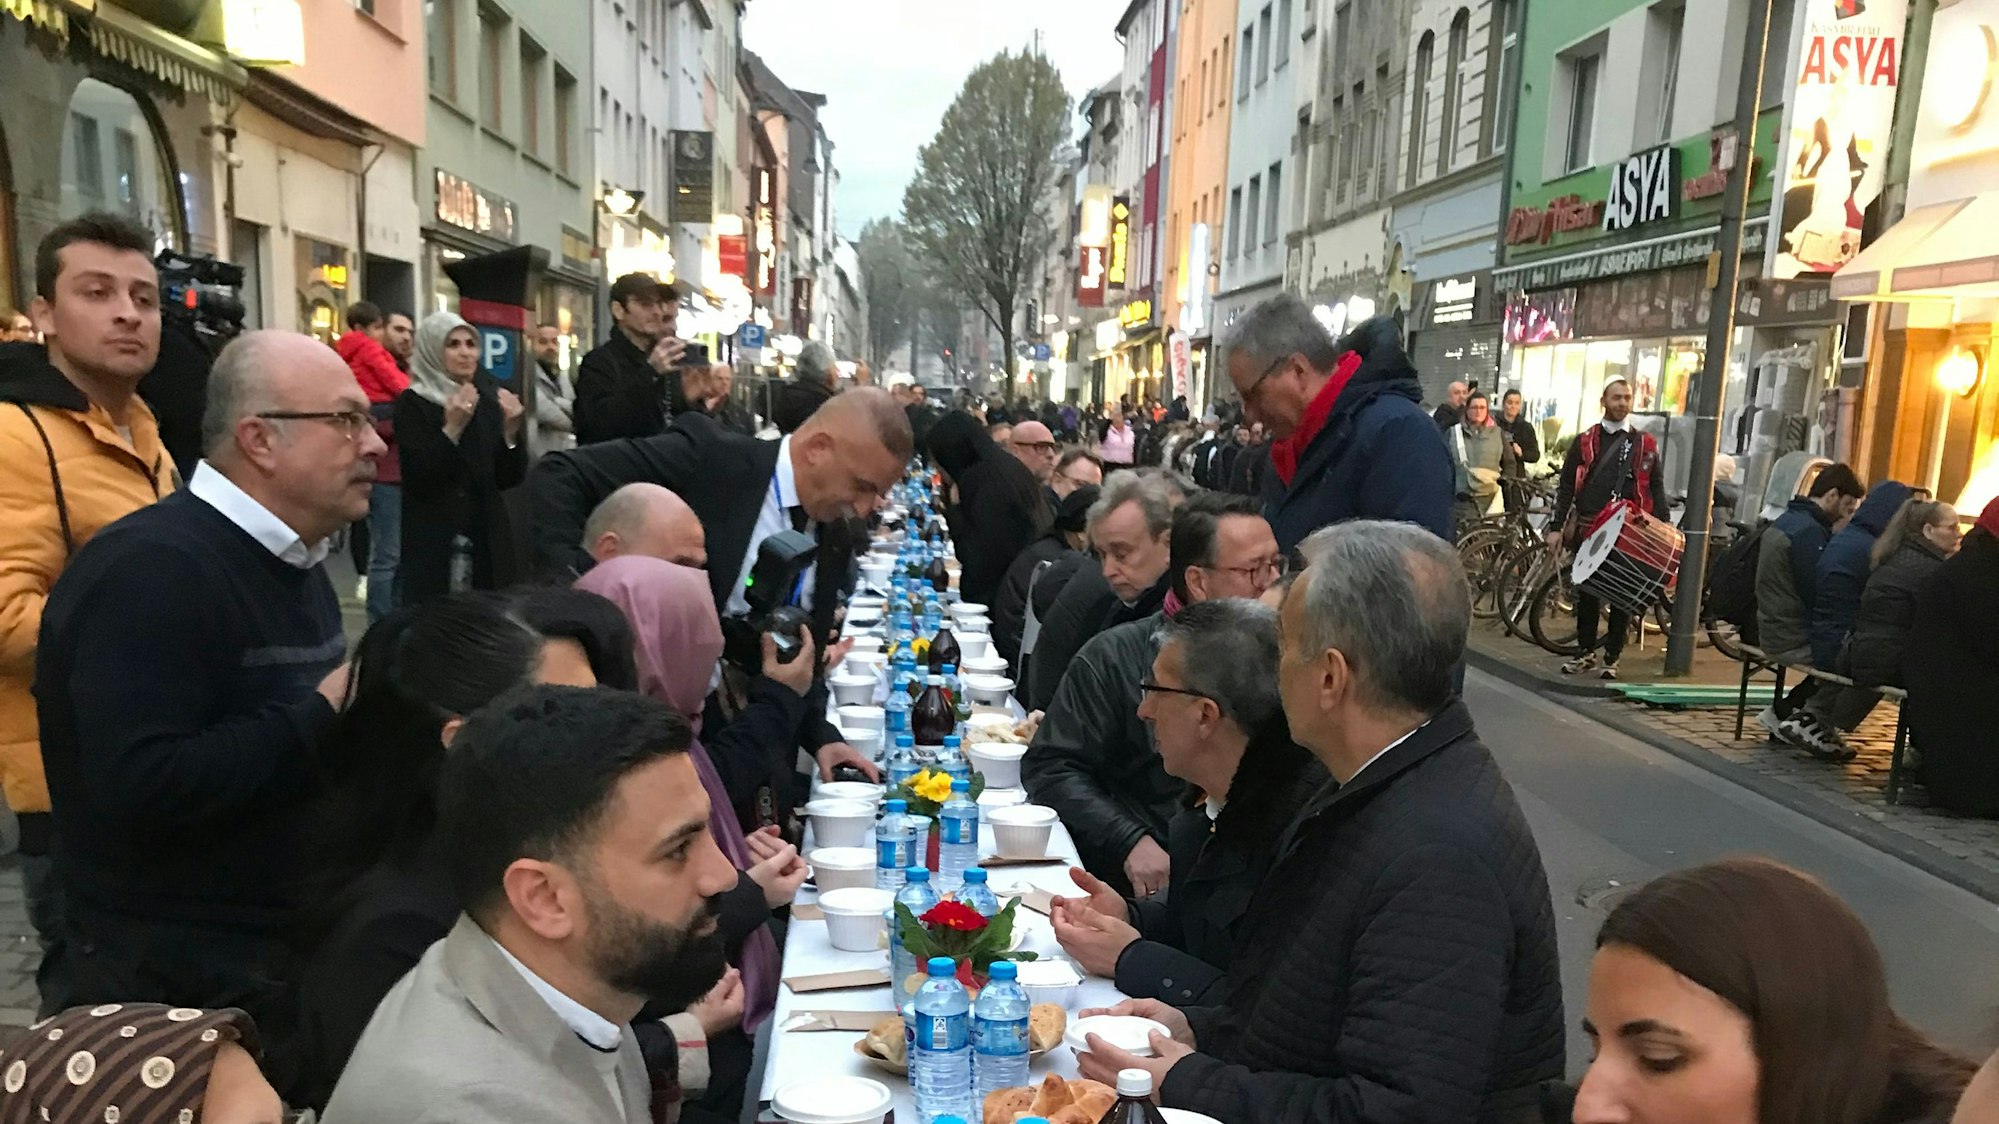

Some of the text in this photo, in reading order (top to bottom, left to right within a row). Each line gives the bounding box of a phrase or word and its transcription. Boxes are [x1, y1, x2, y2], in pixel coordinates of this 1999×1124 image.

[1799, 35, 1897, 87] ASYA
[1602, 146, 1670, 232] ASYA
[484, 333, 508, 369] P
